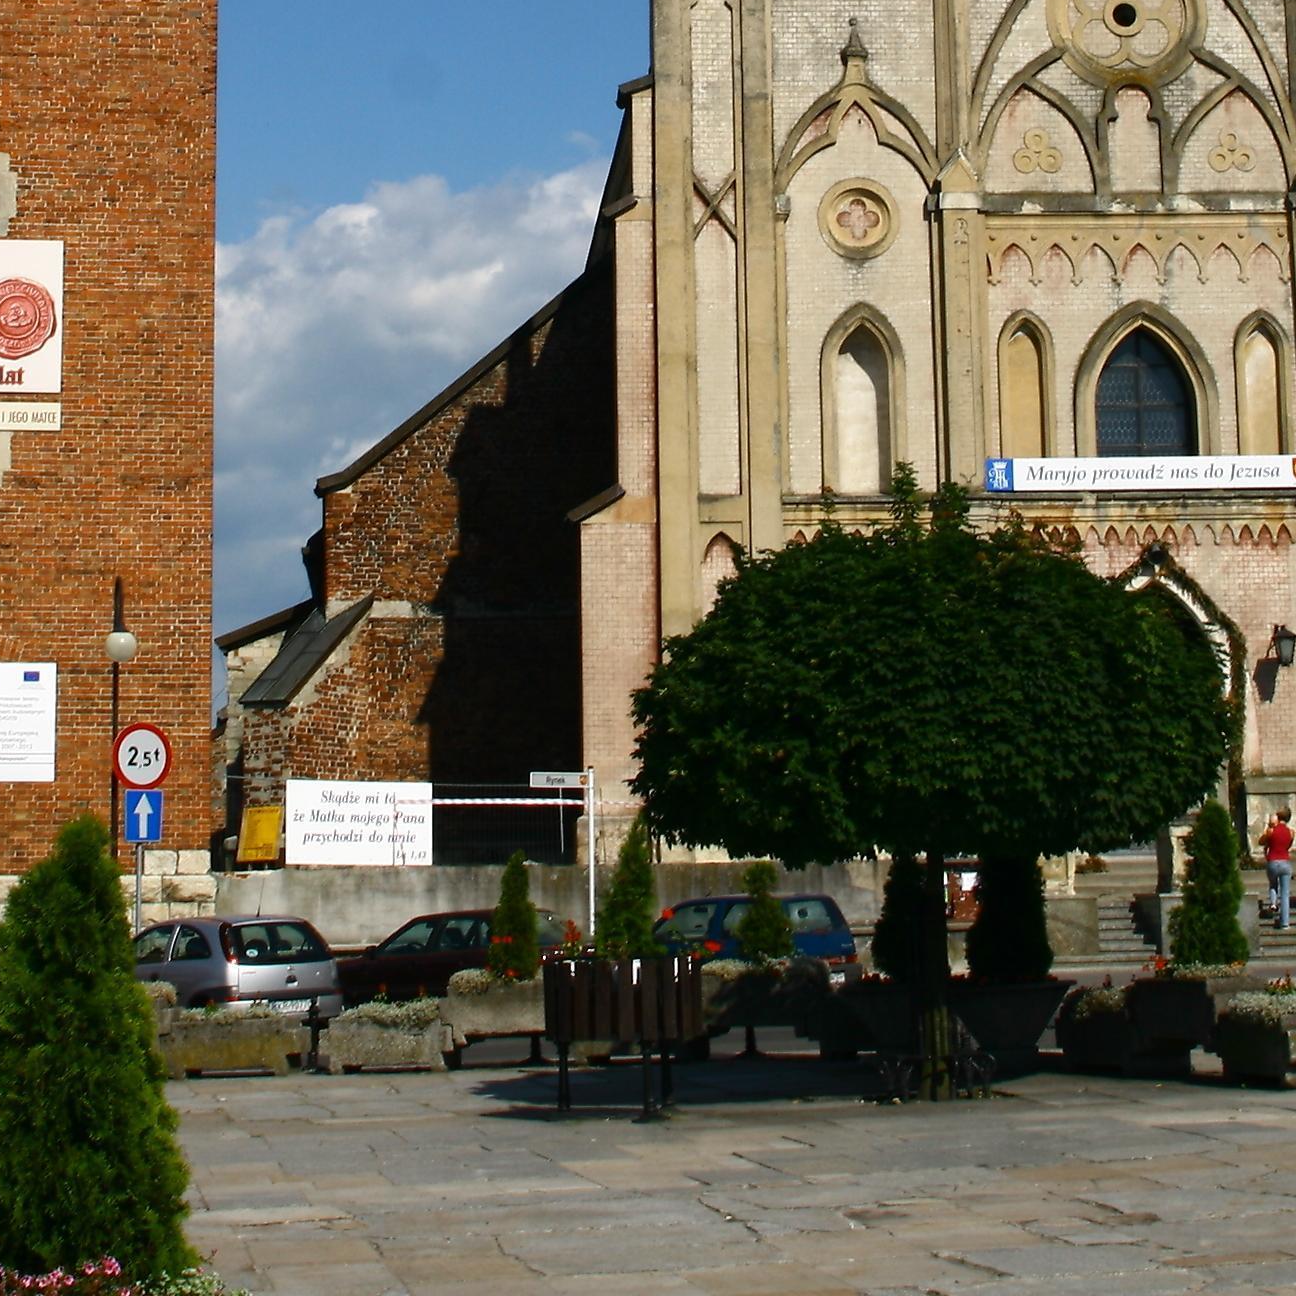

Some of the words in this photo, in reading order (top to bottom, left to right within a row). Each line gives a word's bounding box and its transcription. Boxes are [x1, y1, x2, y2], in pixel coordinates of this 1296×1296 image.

[1, 411, 5, 424] I
[7, 411, 29, 424] JEGO
[31, 411, 57, 424] MATCE
[1025, 465, 1087, 486] Maryjo
[1091, 464, 1166, 485] prowadź
[1170, 467, 1199, 480] nas
[1203, 463, 1224, 479] do
[1230, 463, 1281, 482] Jezusa
[320, 790, 361, 806] Skądże
[365, 791, 380, 805] mi
[293, 809, 305, 823] że
[309, 809, 345, 823] Matka
[350, 811, 390, 826] mojego
[394, 811, 425, 824] Pana
[302, 829, 363, 845] przychodzi
[368, 830, 383, 843] do
[387, 830, 416, 843] mnie
